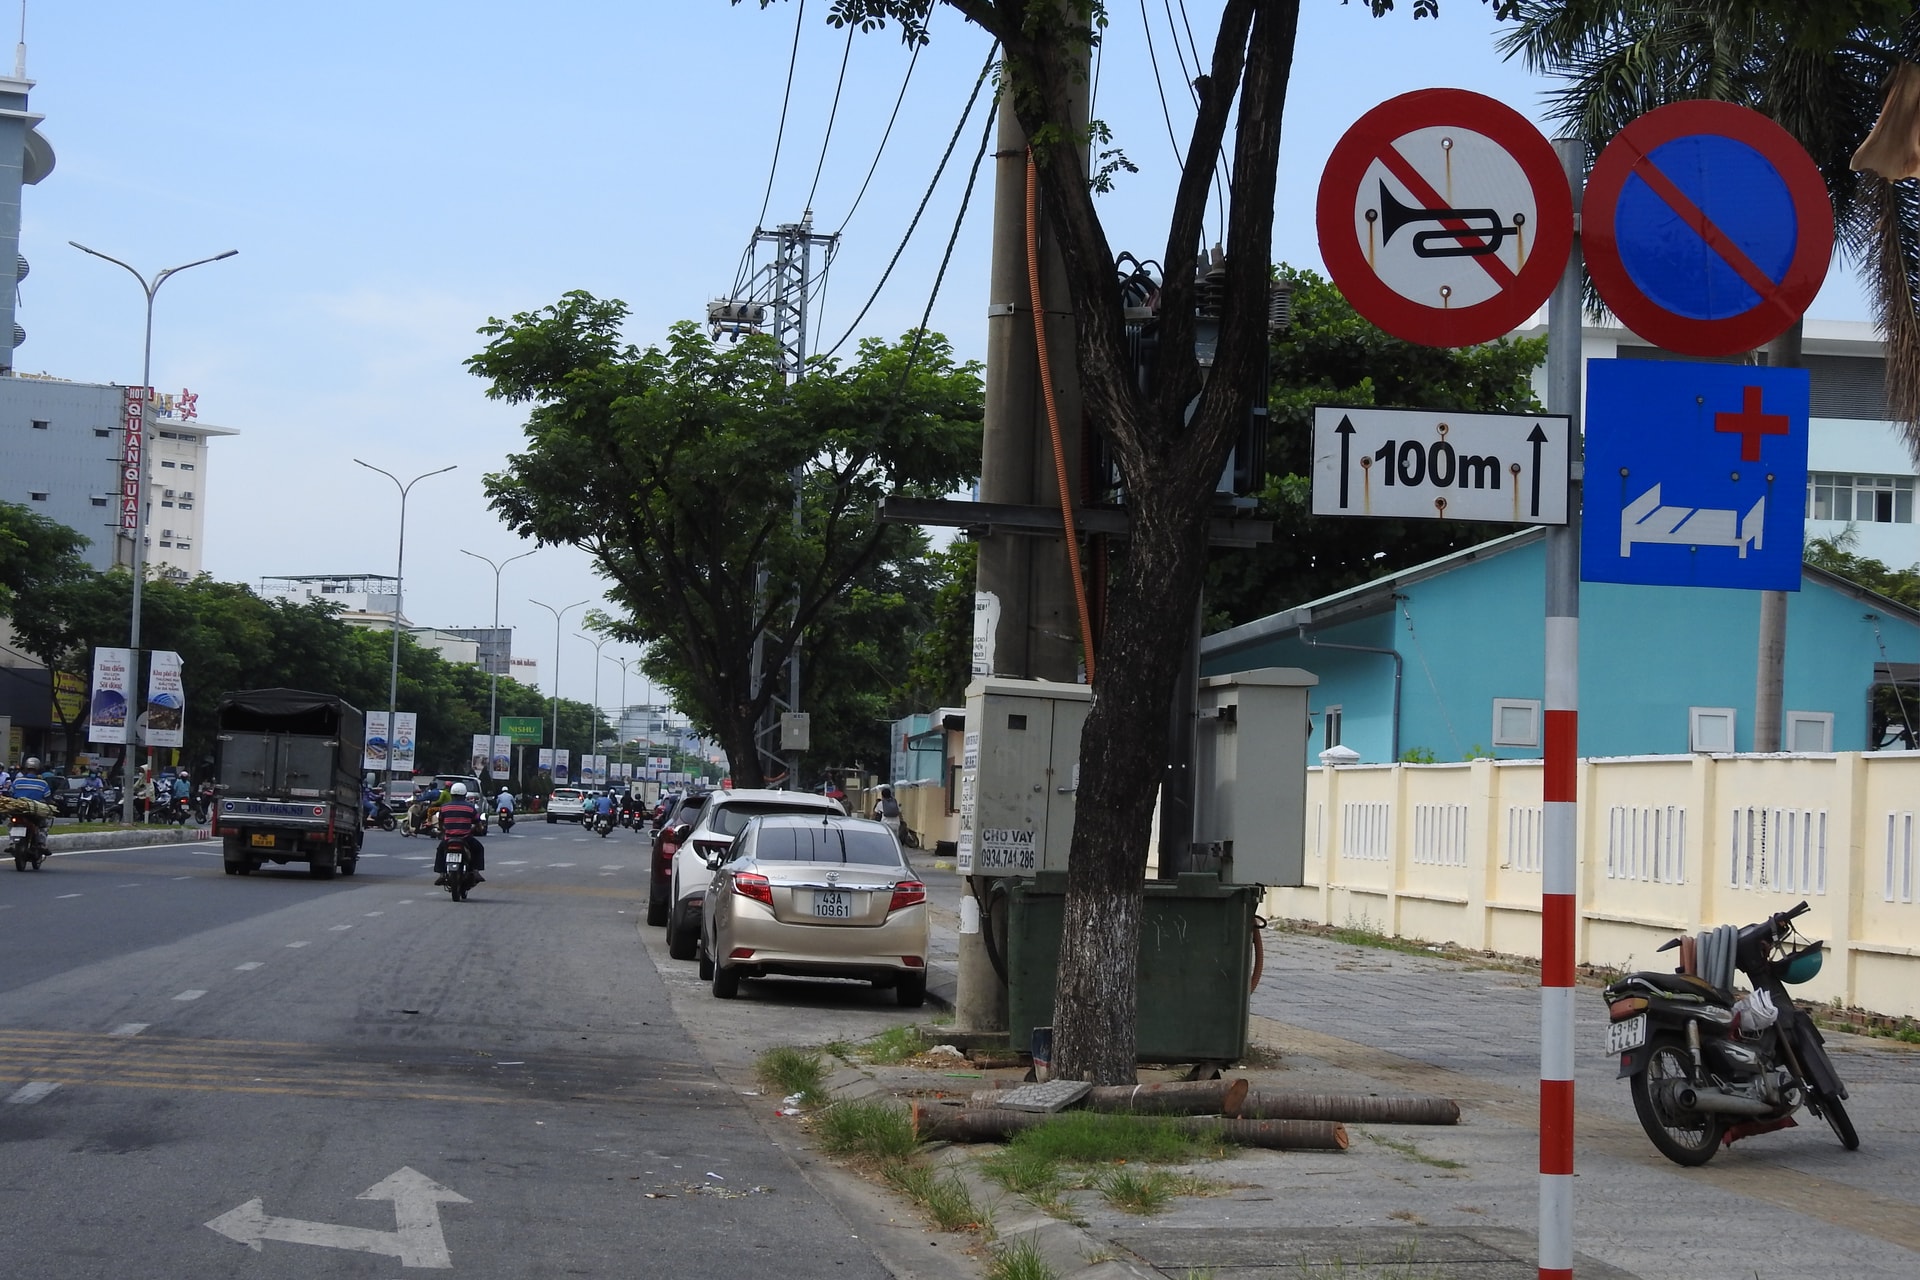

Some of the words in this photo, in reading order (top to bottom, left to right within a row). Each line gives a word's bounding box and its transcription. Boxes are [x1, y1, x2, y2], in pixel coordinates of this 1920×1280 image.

[129, 387, 153, 400] HOTL
[1374, 440, 1501, 490] 100m
[982, 829, 1009, 843] CHO
[1011, 830, 1035, 844] VAY
[981, 848, 1035, 870] 0934.741.286
[822, 892, 843, 905] 43A
[816, 904, 850, 918] 109.61
[1611, 1017, 1640, 1037] 43-H3
[1611, 1032, 1638, 1052] 1441
